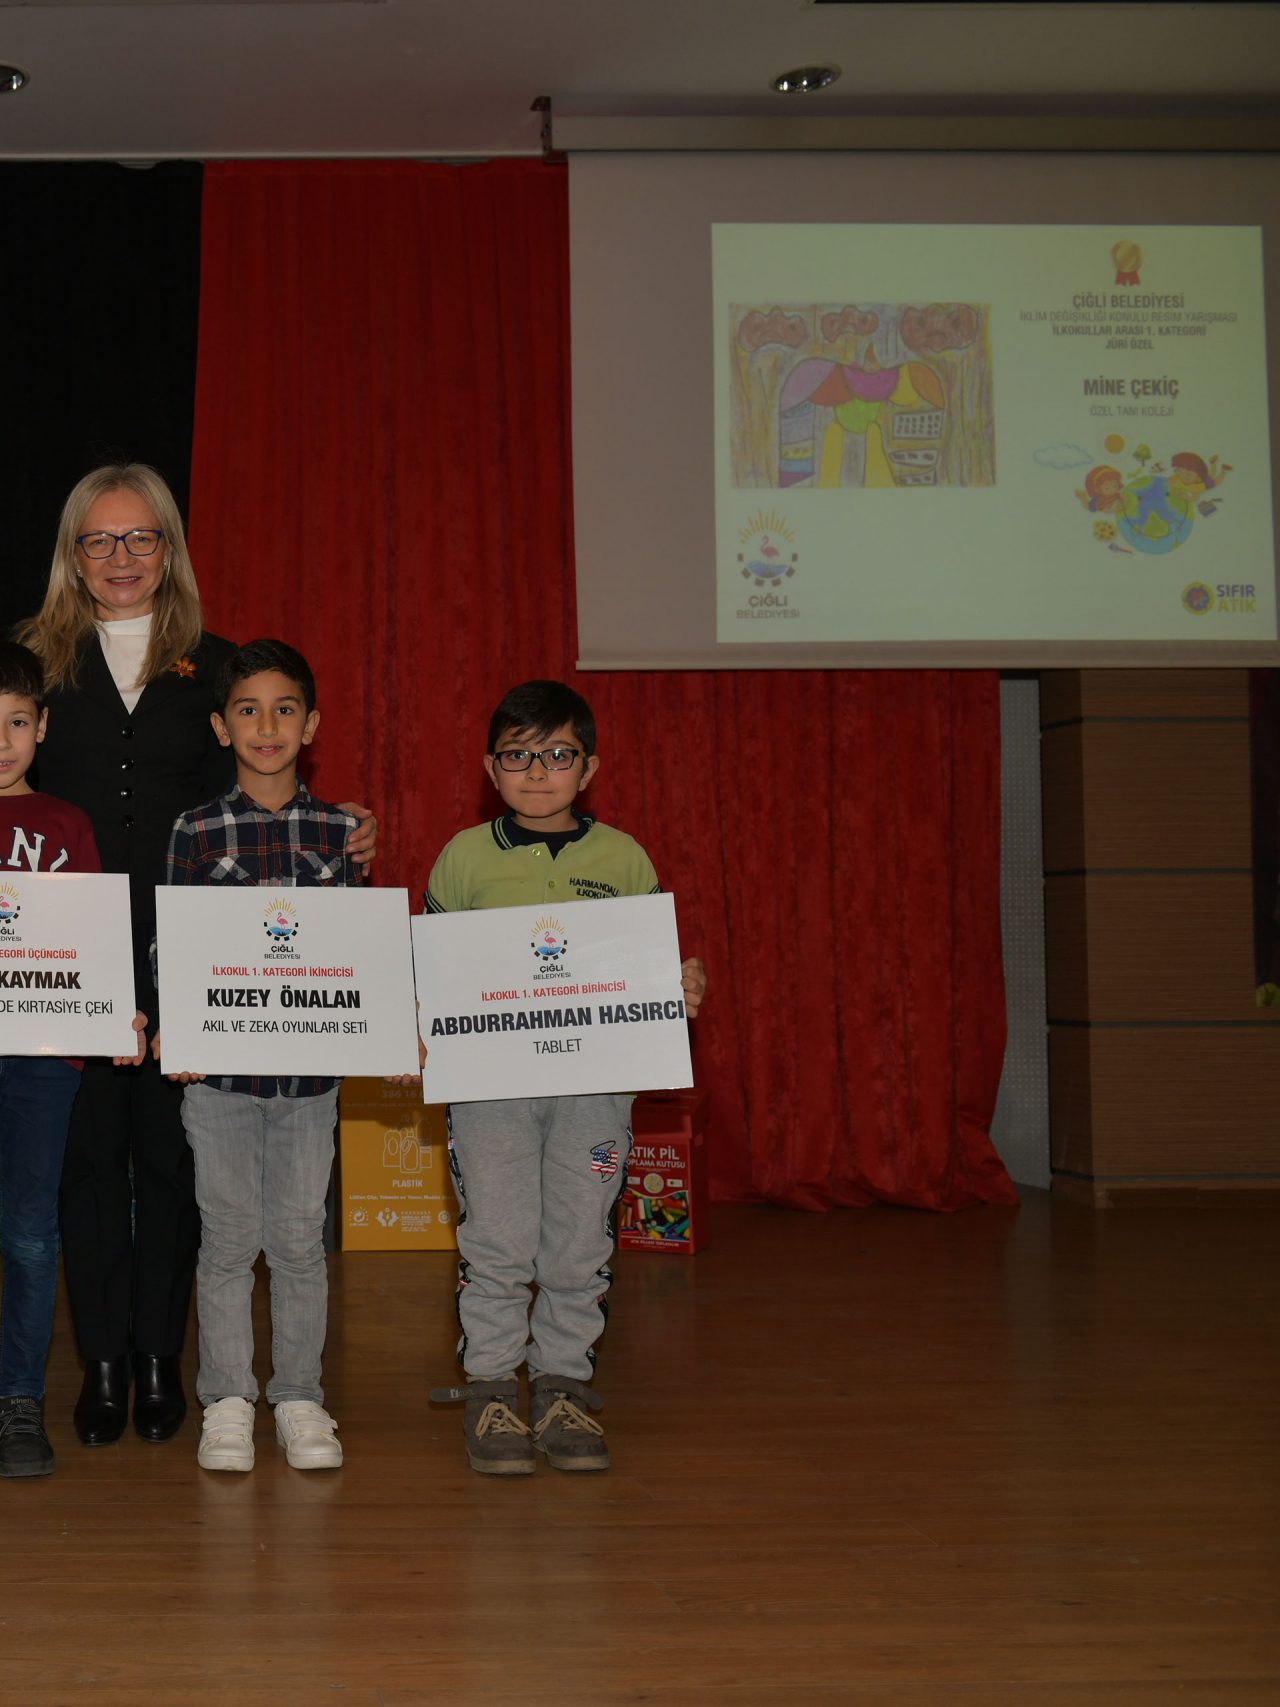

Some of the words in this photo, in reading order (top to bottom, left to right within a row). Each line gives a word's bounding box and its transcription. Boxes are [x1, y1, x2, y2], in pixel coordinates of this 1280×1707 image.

[1073, 294, 1106, 309] ÇİĞLİ
[1111, 292, 1184, 308] BELEDİYESİ
[1109, 312, 1148, 322] KONULU
[1052, 324, 1112, 336] İLKOKULLAR
[1115, 325, 1144, 336] ARASI
[1158, 324, 1206, 336] KATEGORİ
[1105, 338, 1128, 350] JÜRİ
[1130, 338, 1154, 350] ÖZEL
[1084, 375, 1125, 396] MİNE
[1131, 375, 1179, 399] ÇEKİÇ
[1089, 405, 1114, 417] ÖZEL
[1117, 406, 1138, 417] TANI
[1216, 584, 1255, 597] SIFIR
[1218, 599, 1256, 612] ATIK
[28, 948, 77, 960] ÜÇÜNCÜSÜ
[212, 965, 250, 976] İLKOKUL
[252, 967, 260, 976] 1.
[263, 966, 307, 977] KATEGORİ
[309, 966, 353, 977] İKİNCİCİSİ
[207, 988, 270, 1007] KUZEY
[280, 984, 361, 1008] ÖNALAN
[481, 989, 520, 1001] İLKOKUL
[522, 988, 531, 998] 1.
[533, 984, 580, 998] KATEGORİ
[582, 980, 626, 995] BİRİNCİSİ
[18, 998, 81, 1014] KIRTASİYE
[85, 999, 113, 1017] ÇEKİ
[431, 1006, 592, 1036] ABDURRAHMAN
[598, 1000, 685, 1024] HASIRCI
[202, 1020, 228, 1032] AKIL
[231, 1020, 246, 1032] VE
[249, 1020, 279, 1033] ZEKA
[282, 1021, 339, 1034] OYUNLARI
[343, 1019, 367, 1034] SETİ
[533, 1038, 582, 1055] TABLET
[660, 1145, 680, 1160] PİL
[656, 1161, 686, 1169] KUTUSU
[392, 1178, 423, 1188] PLASTİK
